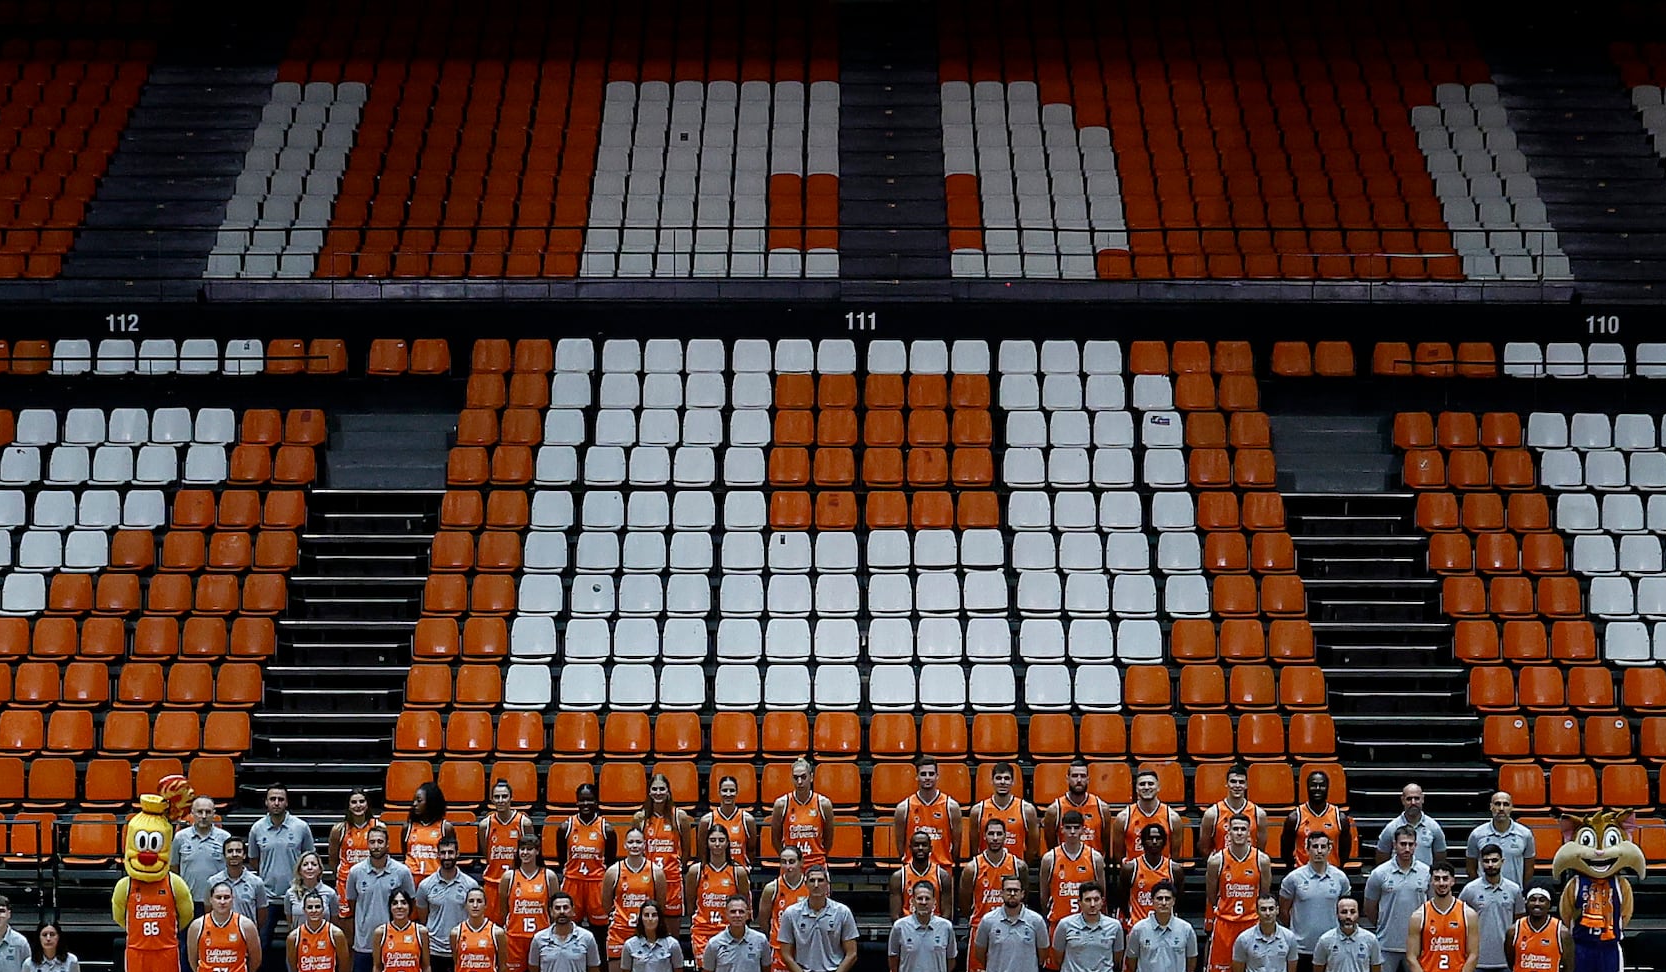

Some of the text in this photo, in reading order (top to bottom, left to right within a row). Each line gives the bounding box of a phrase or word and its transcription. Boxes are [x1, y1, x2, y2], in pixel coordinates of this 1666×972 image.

[106, 314, 139, 331] 112
[846, 312, 875, 330] 111
[1586, 316, 1619, 333] 110
[579, 863, 588, 875] 4
[1235, 900, 1243, 914] 6
[523, 918, 536, 932] 15
[1439, 955, 1449, 969] 2
